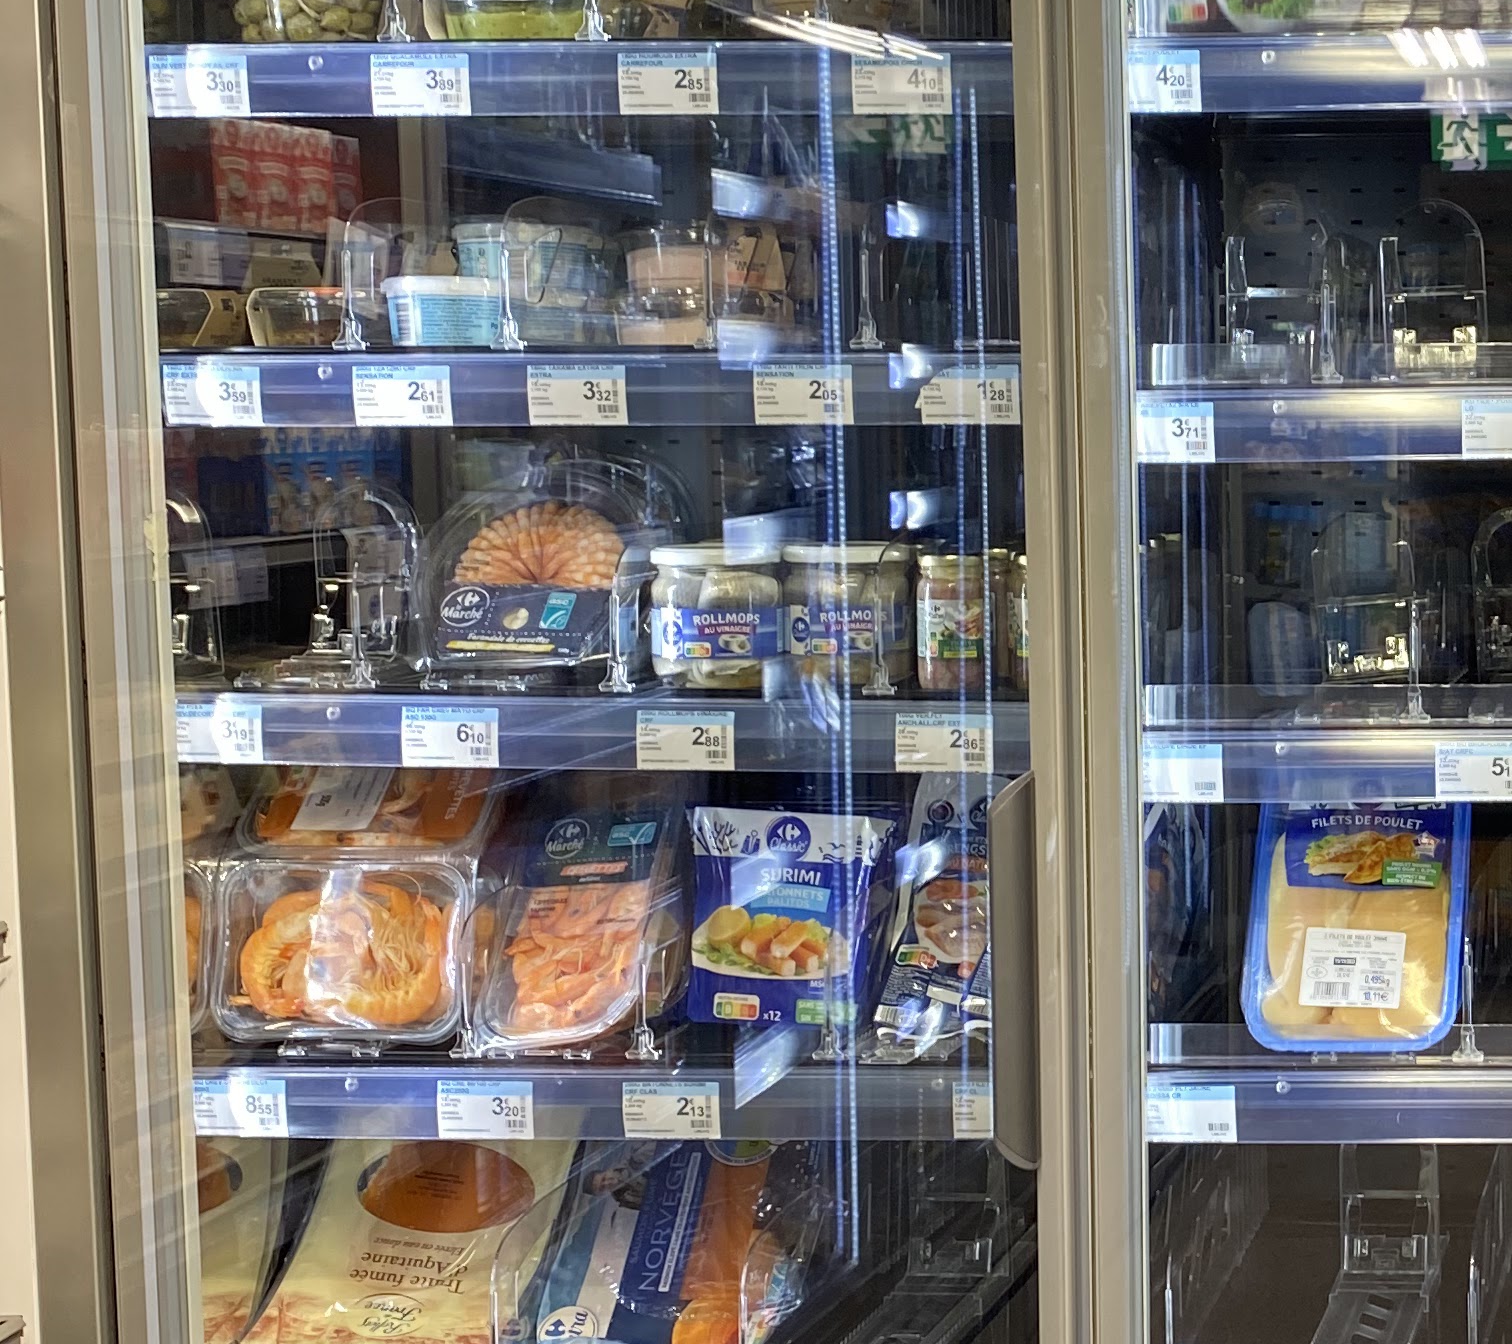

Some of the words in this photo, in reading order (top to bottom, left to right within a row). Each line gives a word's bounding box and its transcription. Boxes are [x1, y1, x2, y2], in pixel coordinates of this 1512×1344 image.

[440, 606, 484, 620] Marché
[692, 611, 761, 626] ROLLMOPS
[703, 625, 715, 635] AU
[715, 624, 752, 635] VINAIGRE
[1311, 814, 1353, 829] FILETS
[1355, 814, 1372, 826] DE
[1373, 816, 1424, 831] POULET
[545, 839, 585, 853] Marché
[769, 836, 806, 854] Classic
[760, 866, 822, 887] SURIMI
[762, 1010, 782, 1022] x12
[360, 1251, 469, 1277] d'Aquitaine
[349, 1268, 405, 1288] fumée
[409, 1275, 465, 1295] Truite
